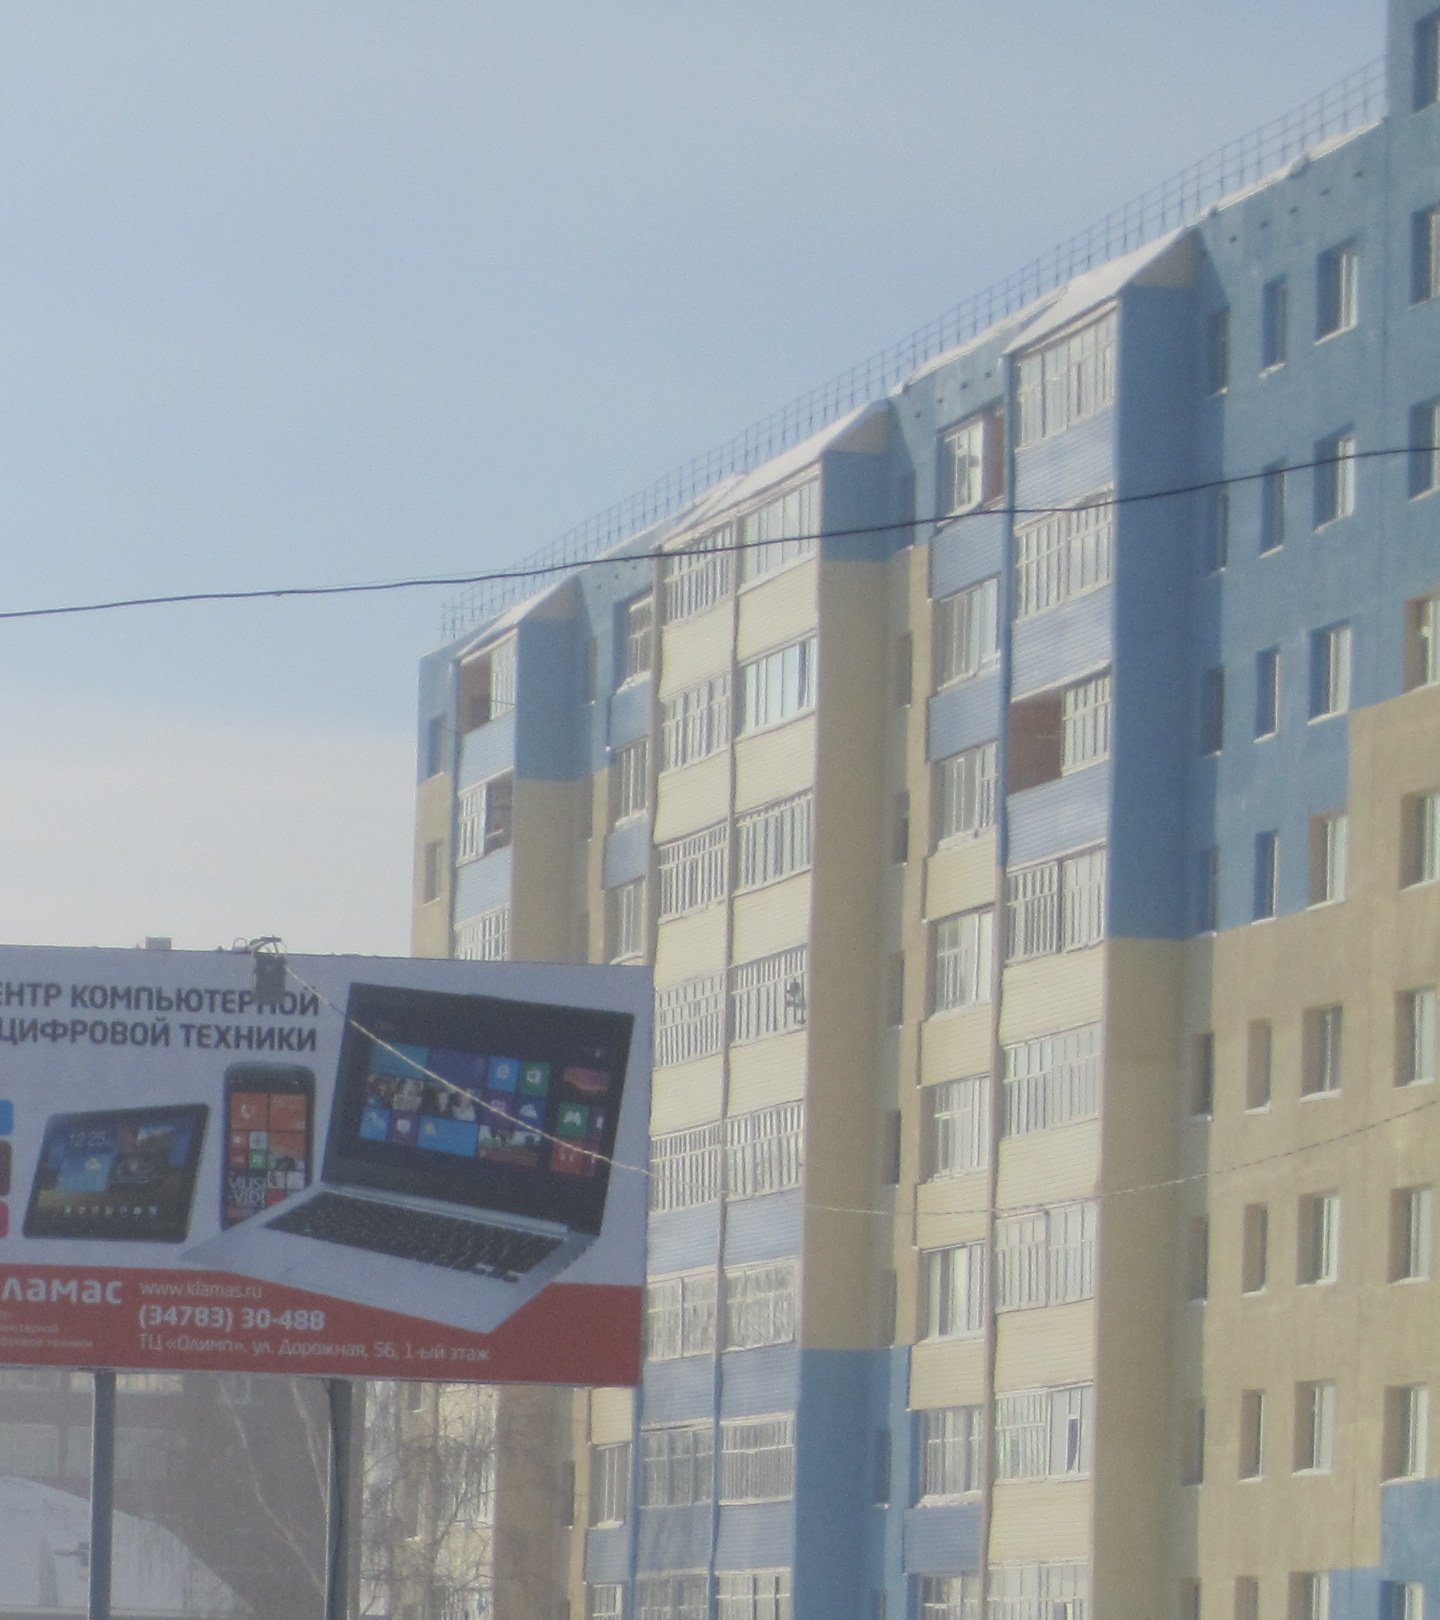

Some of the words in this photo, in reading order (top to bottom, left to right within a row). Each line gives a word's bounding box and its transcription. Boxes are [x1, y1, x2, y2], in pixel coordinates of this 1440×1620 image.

[179, 1022, 317, 1052] ТЕХНИКИ
[139, 1280, 262, 1298] www.klamas.ru
[138, 1306, 234, 1331] (34783)
[241, 1308, 326, 1331] 30-488
